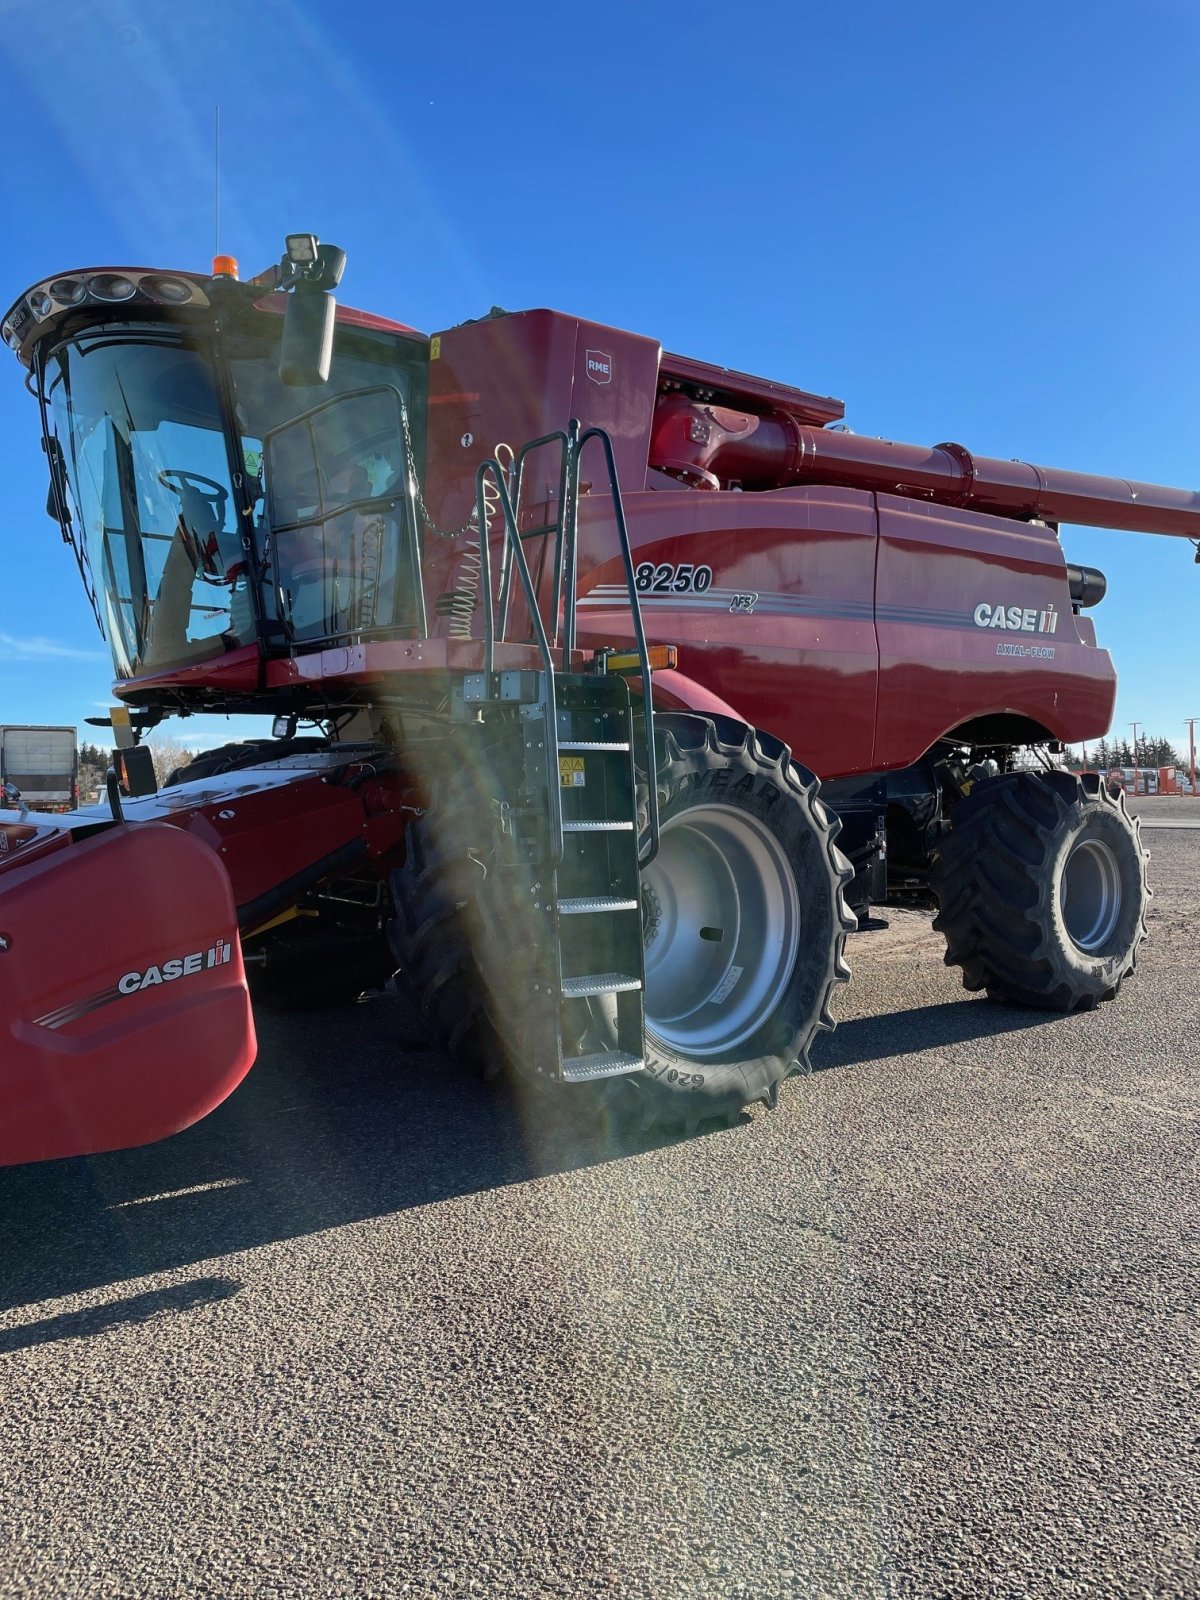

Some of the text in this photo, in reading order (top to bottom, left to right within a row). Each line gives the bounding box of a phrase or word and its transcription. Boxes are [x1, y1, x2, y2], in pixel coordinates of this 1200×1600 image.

[588, 359, 610, 374] RME
[634, 561, 713, 594] 8250
[730, 593, 752, 608] AFS
[973, 603, 1037, 632] CASE
[118, 951, 203, 994] CASE
